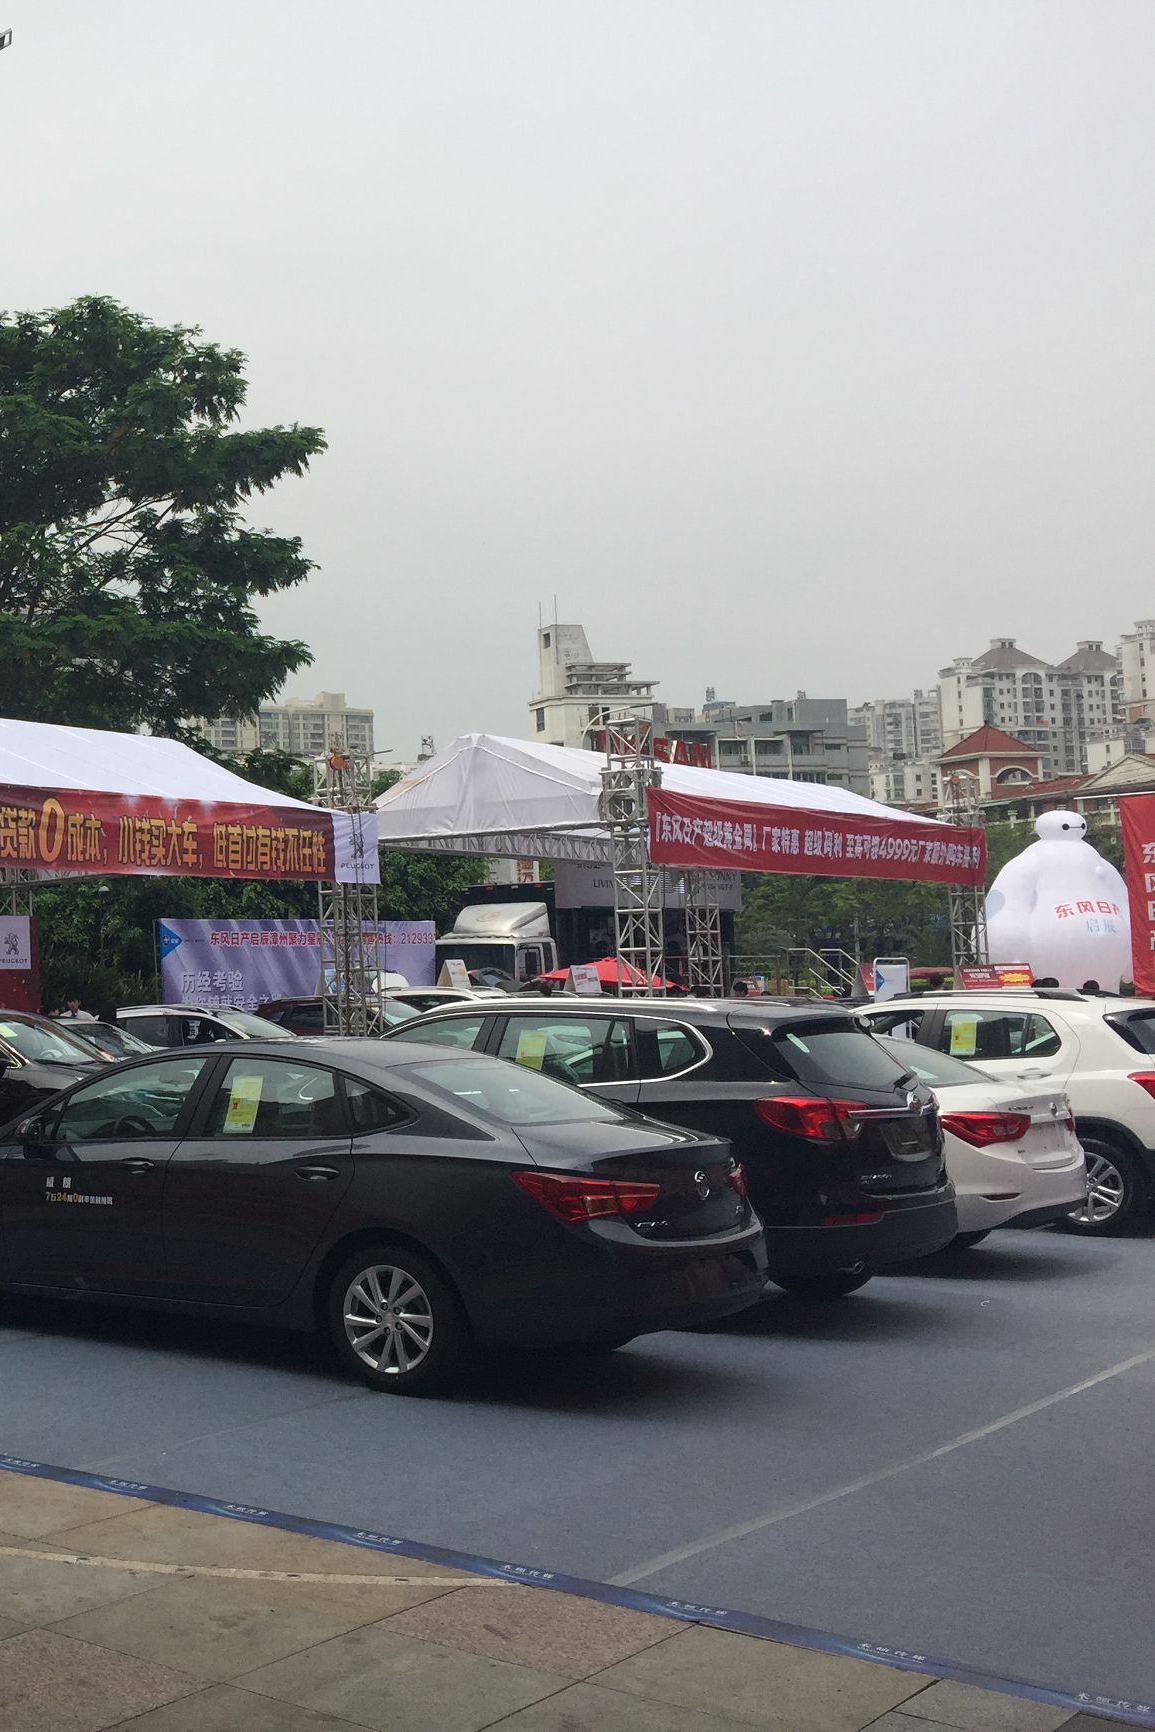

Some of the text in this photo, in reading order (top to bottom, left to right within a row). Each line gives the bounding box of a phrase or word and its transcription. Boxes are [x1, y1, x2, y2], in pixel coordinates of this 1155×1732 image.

[590, 729, 712, 769] SAN
[210, 931, 356, 947] 东风日产启辰漳州聚力星
[182, 970, 244, 993] 历经考验
